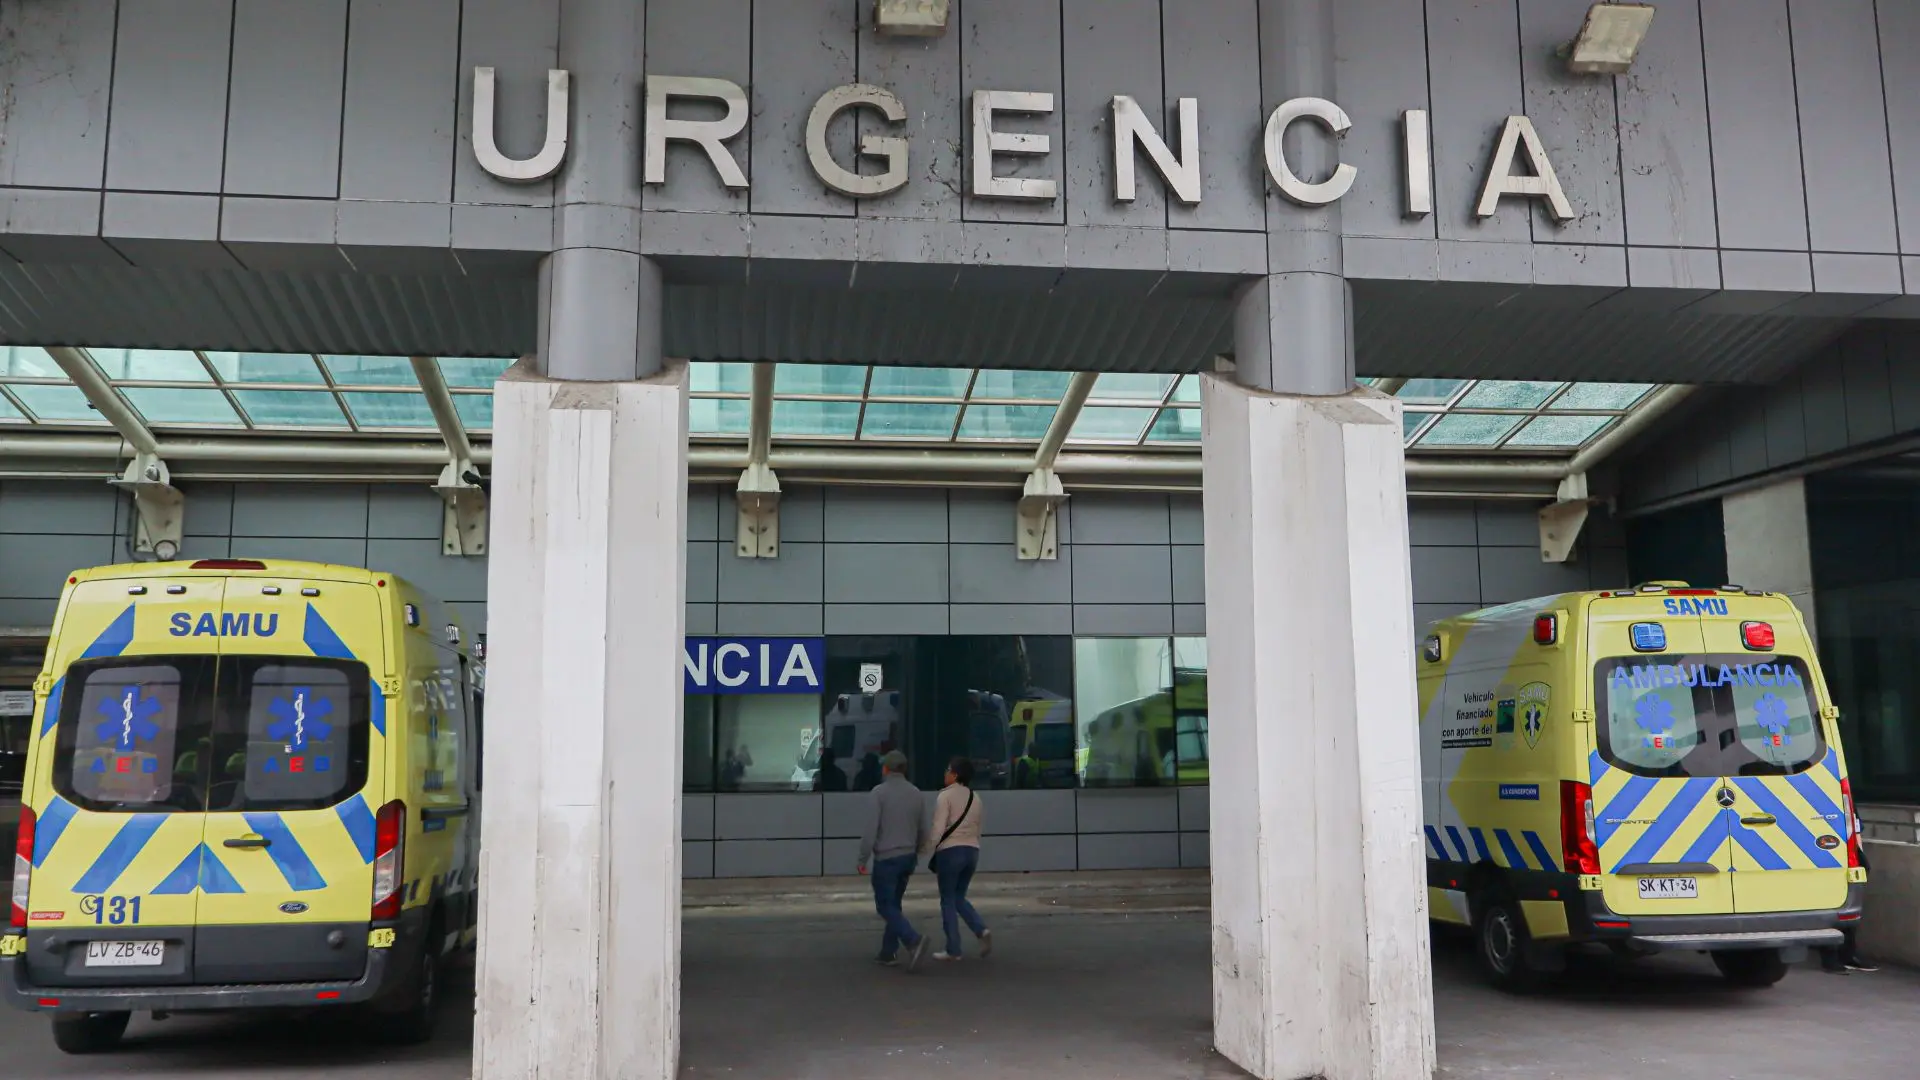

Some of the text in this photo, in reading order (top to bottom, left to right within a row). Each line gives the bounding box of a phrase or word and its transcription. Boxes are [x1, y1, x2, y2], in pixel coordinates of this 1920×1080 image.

[472, 66, 1575, 221] URGENCIA
[1663, 598, 1729, 615] SAMU
[169, 612, 279, 637] SAMU
[1612, 663, 1801, 690] AMBULANCIA
[1456, 708, 1493, 721] financiado
[1442, 724, 1493, 739] con aporte del
[93, 895, 141, 925] 131
